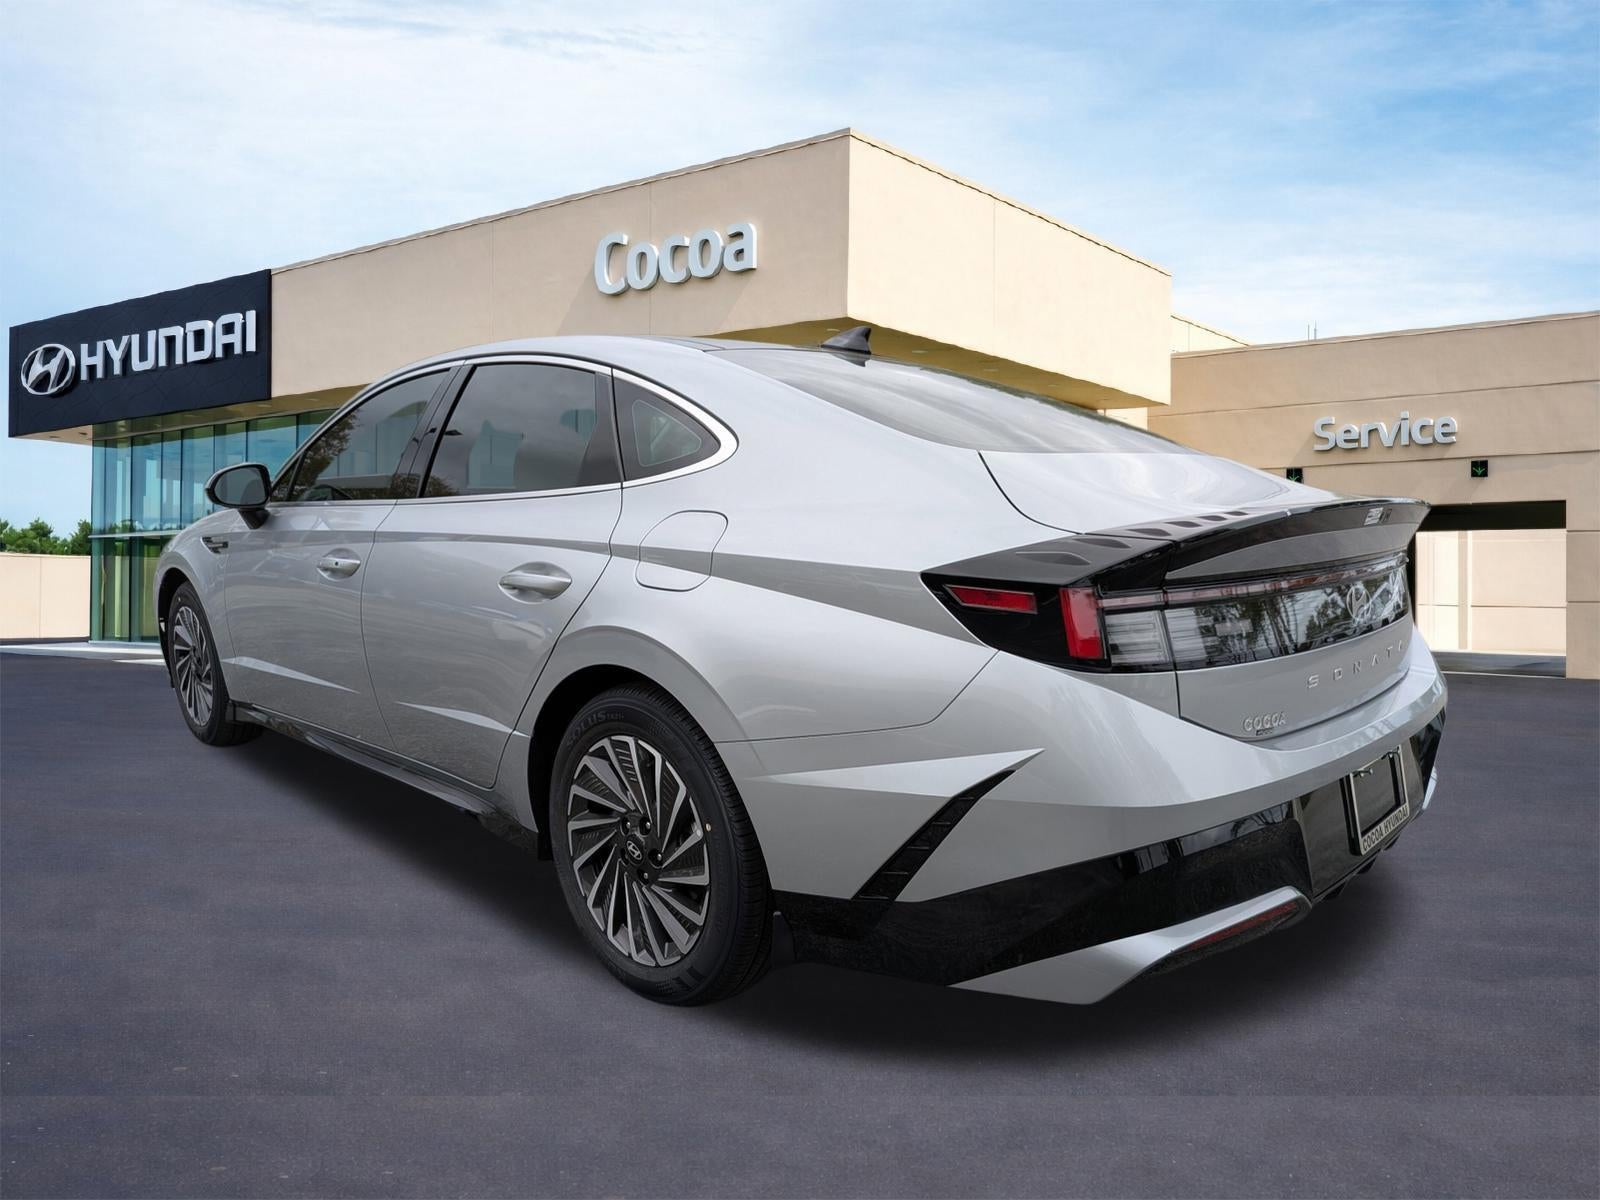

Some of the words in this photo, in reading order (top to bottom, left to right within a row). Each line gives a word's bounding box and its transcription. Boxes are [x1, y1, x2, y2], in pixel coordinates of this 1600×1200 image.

[594, 223, 757, 295] Cocoa
[80, 310, 256, 381] HYUNDAI
[1313, 411, 1458, 451] Service
[1362, 825, 1384, 851] COCOA
[1383, 804, 1408, 834] HYUNDAI
